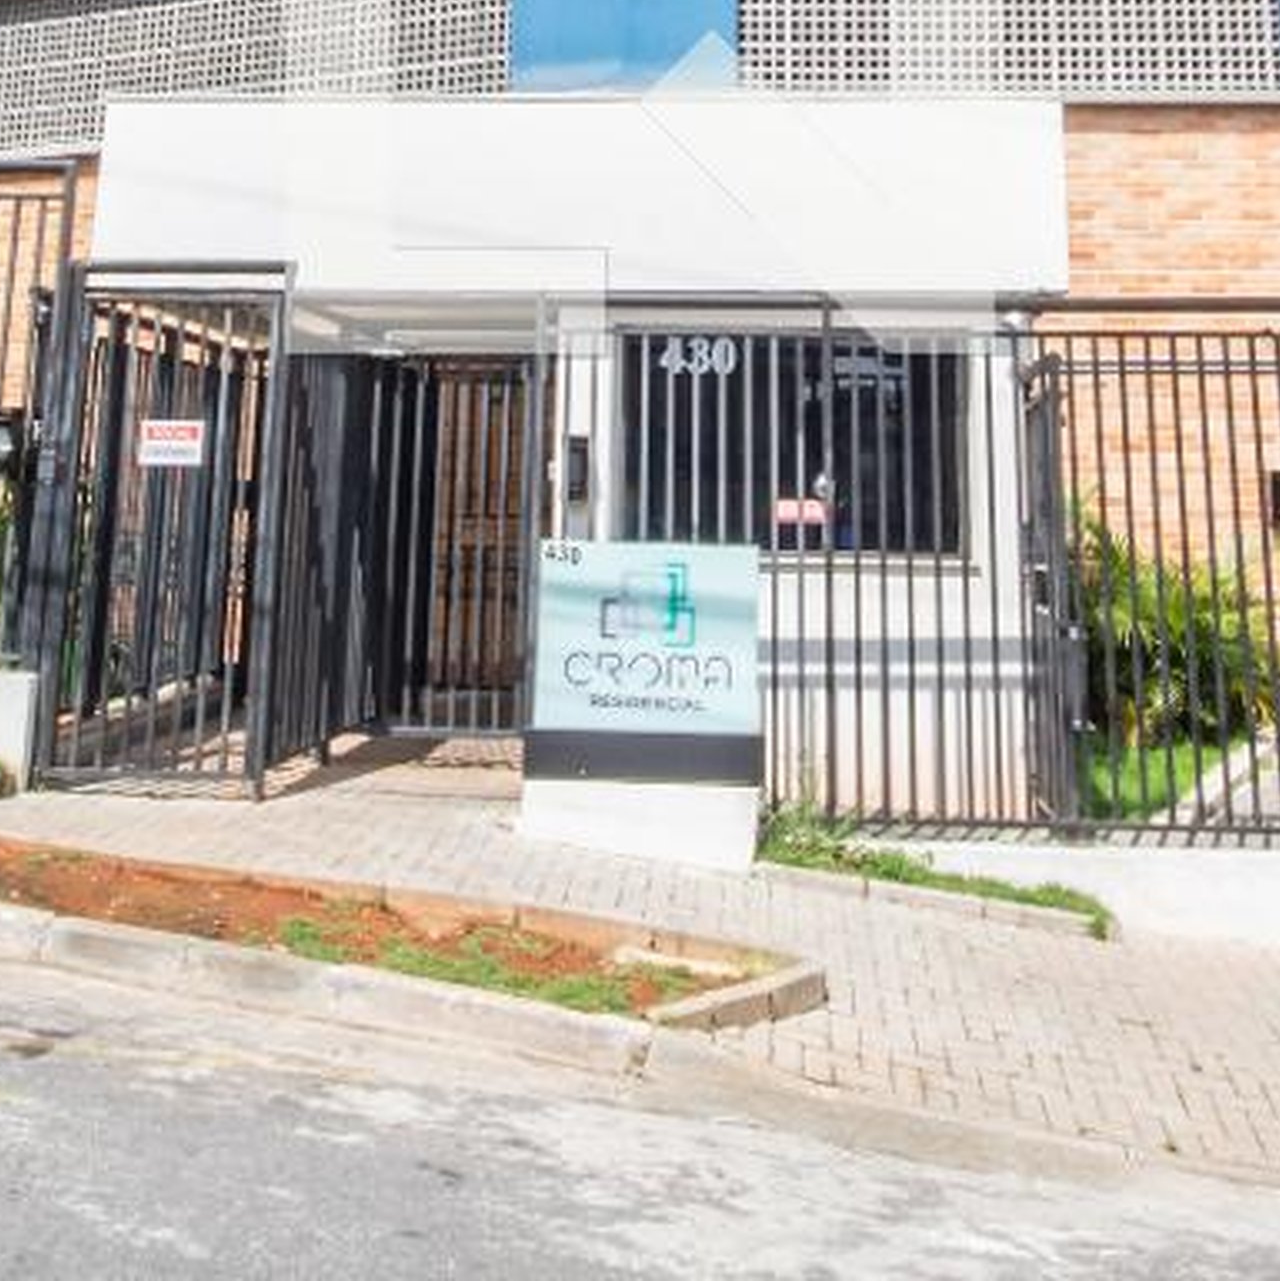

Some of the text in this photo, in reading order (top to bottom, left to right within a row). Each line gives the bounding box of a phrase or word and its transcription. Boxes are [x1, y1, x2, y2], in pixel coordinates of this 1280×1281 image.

[659, 337, 738, 375] 430
[545, 546, 582, 565] 430
[563, 651, 733, 690] CROMA
